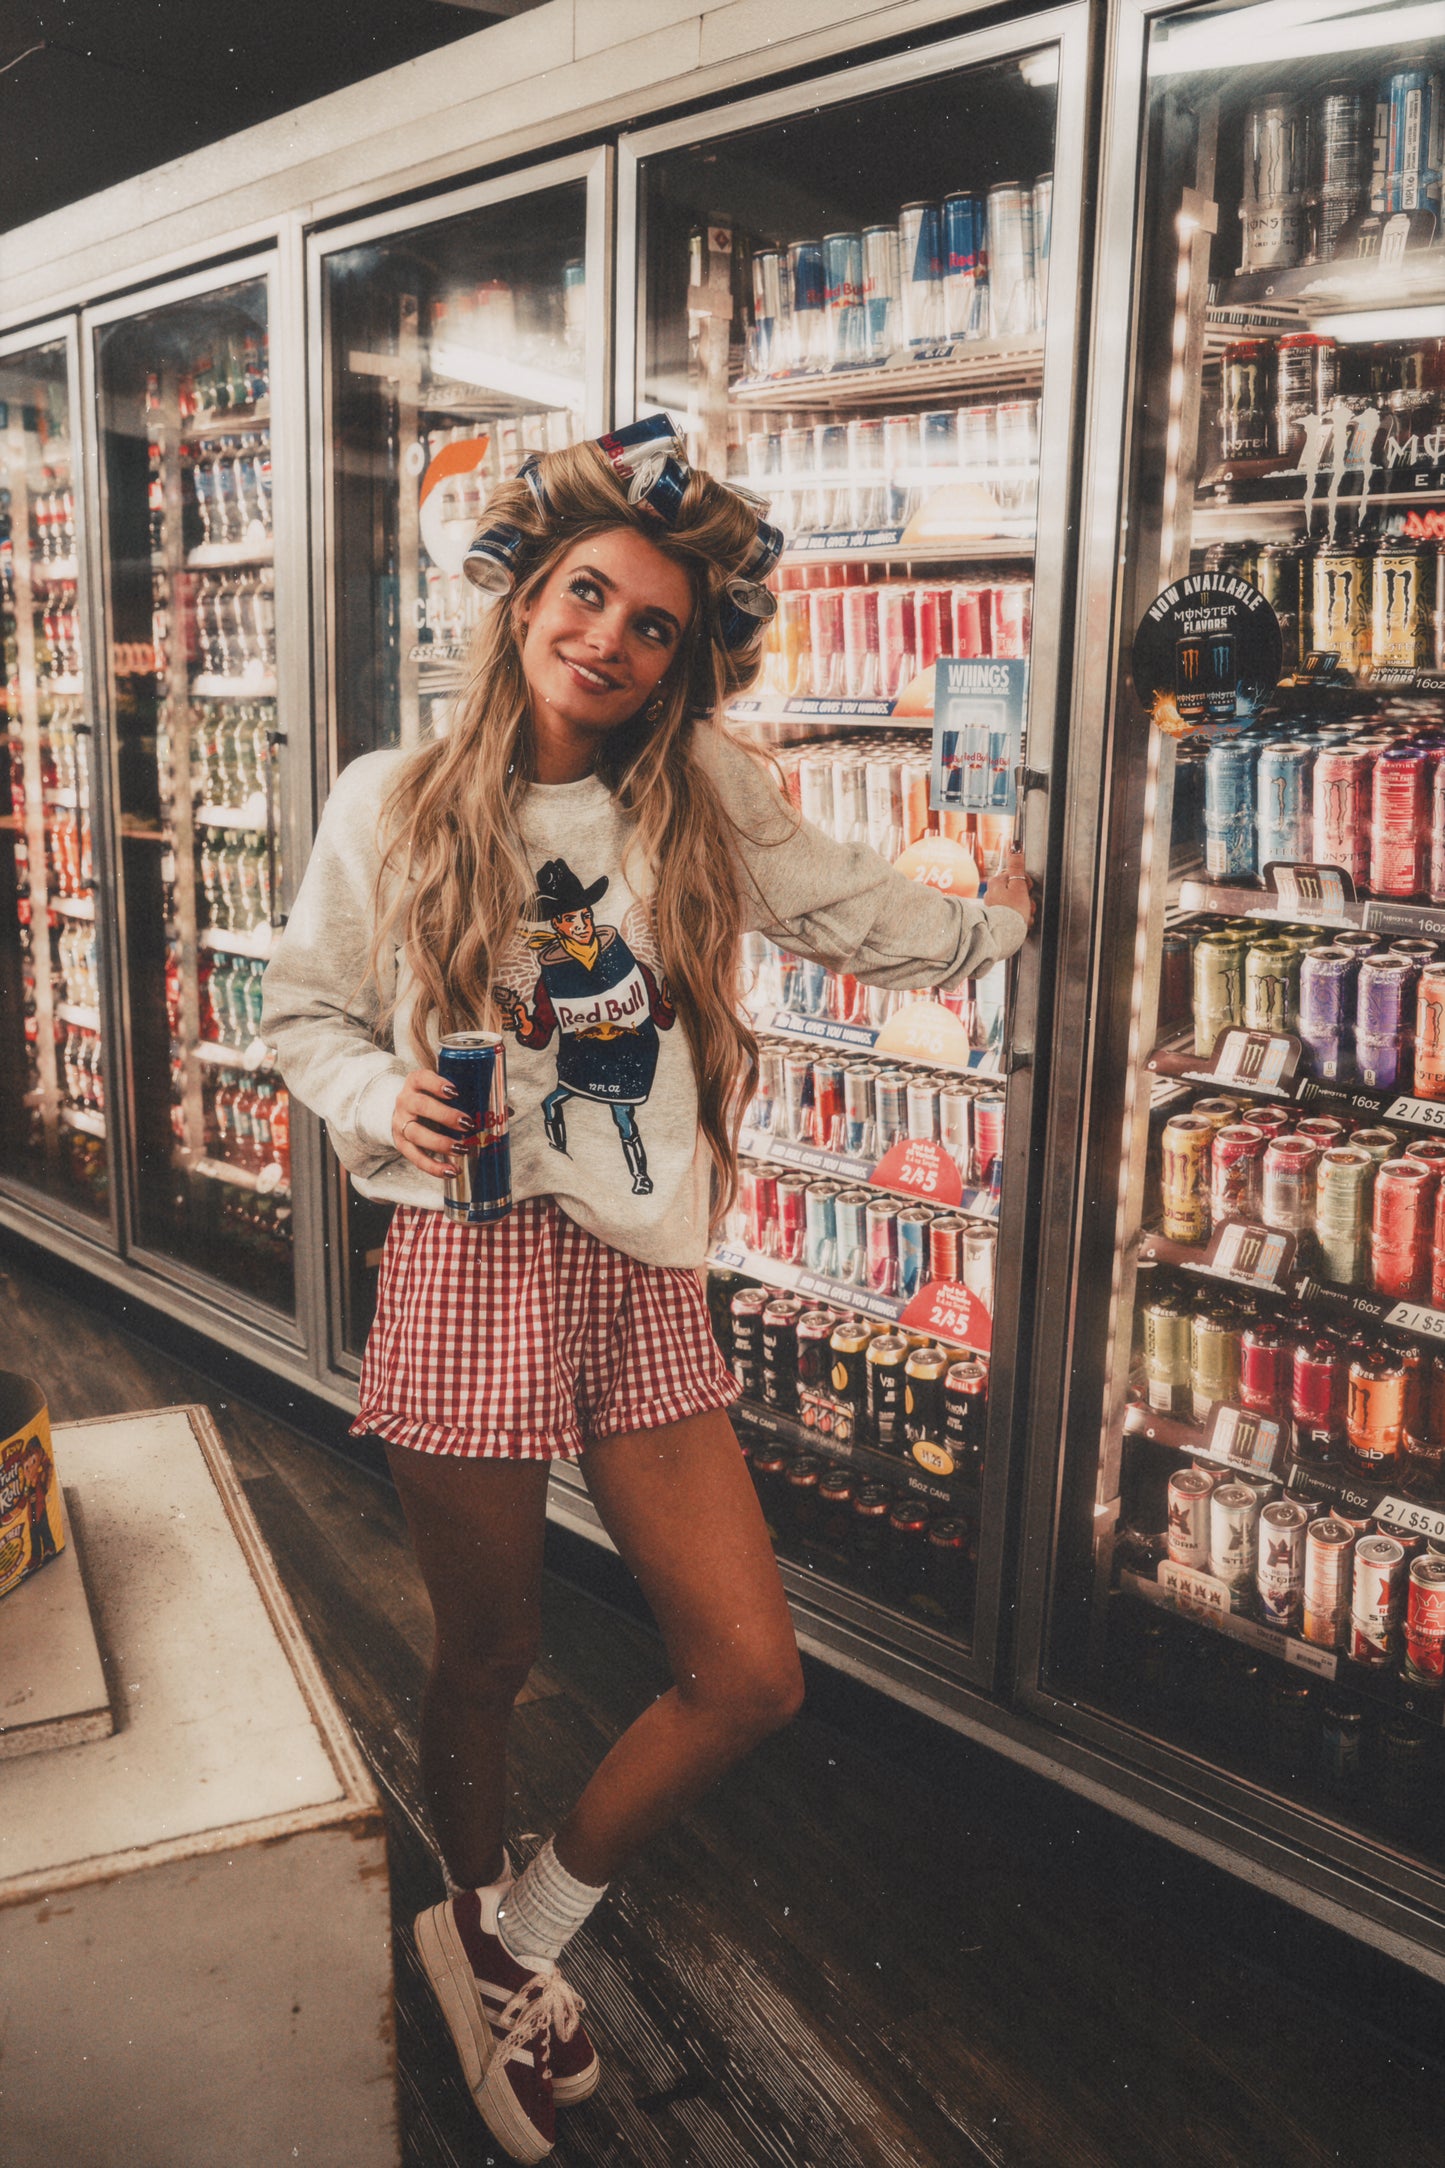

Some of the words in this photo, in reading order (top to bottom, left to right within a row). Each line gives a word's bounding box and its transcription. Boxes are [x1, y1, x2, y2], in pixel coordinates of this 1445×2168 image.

[1149, 586, 1180, 622] NOW
[1184, 574, 1263, 612] AVAILABLE
[1174, 605, 1237, 621] MONSTER
[1184, 618, 1228, 634] FLAVORS
[949, 664, 1010, 688] WIIINGS
[559, 1002, 602, 1028] Red
[604, 981, 645, 1021] Bull
[588, 1083, 598, 1092] 12
[597, 1084, 608, 1093] FL
[608, 1084, 621, 1093] OZ
[1351, 1094, 1381, 1112] 16oz
[1396, 1103, 1409, 1117] 2
[899, 1164, 938, 1192] 2/$5
[929, 1305, 970, 1336] 2/$5
[1352, 1298, 1381, 1315] 16oz
[1396, 1309, 1409, 1323] 2
[1340, 1488, 1369, 1508] 16oz
[1383, 1503, 1395, 1519] 2
